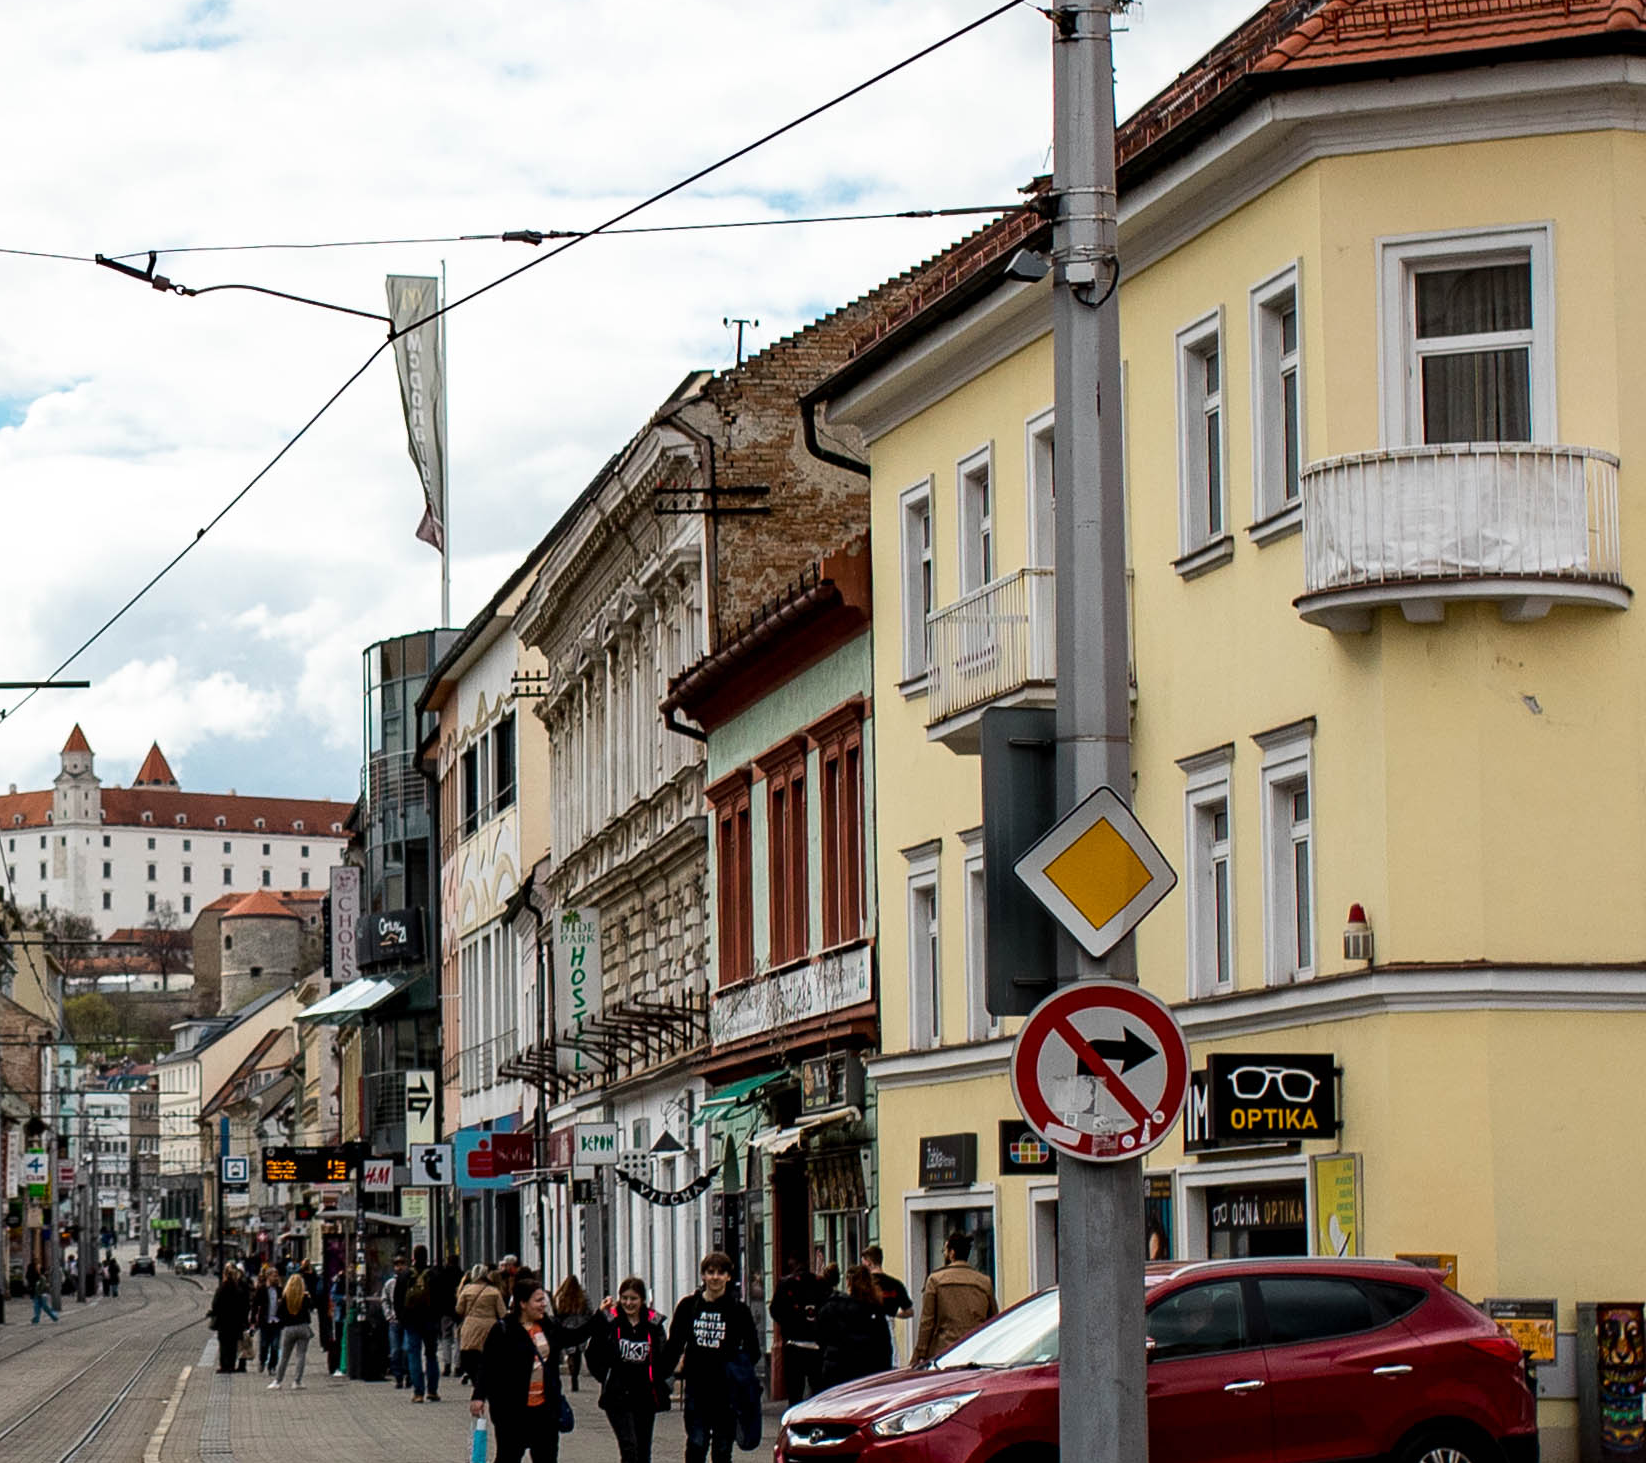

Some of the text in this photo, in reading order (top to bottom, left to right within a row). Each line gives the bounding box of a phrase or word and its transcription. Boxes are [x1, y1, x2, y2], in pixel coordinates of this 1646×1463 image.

[1230, 1108, 1319, 1130] OPTIKA
[1232, 1195, 1304, 1226] OČNÁ OPTIKA
